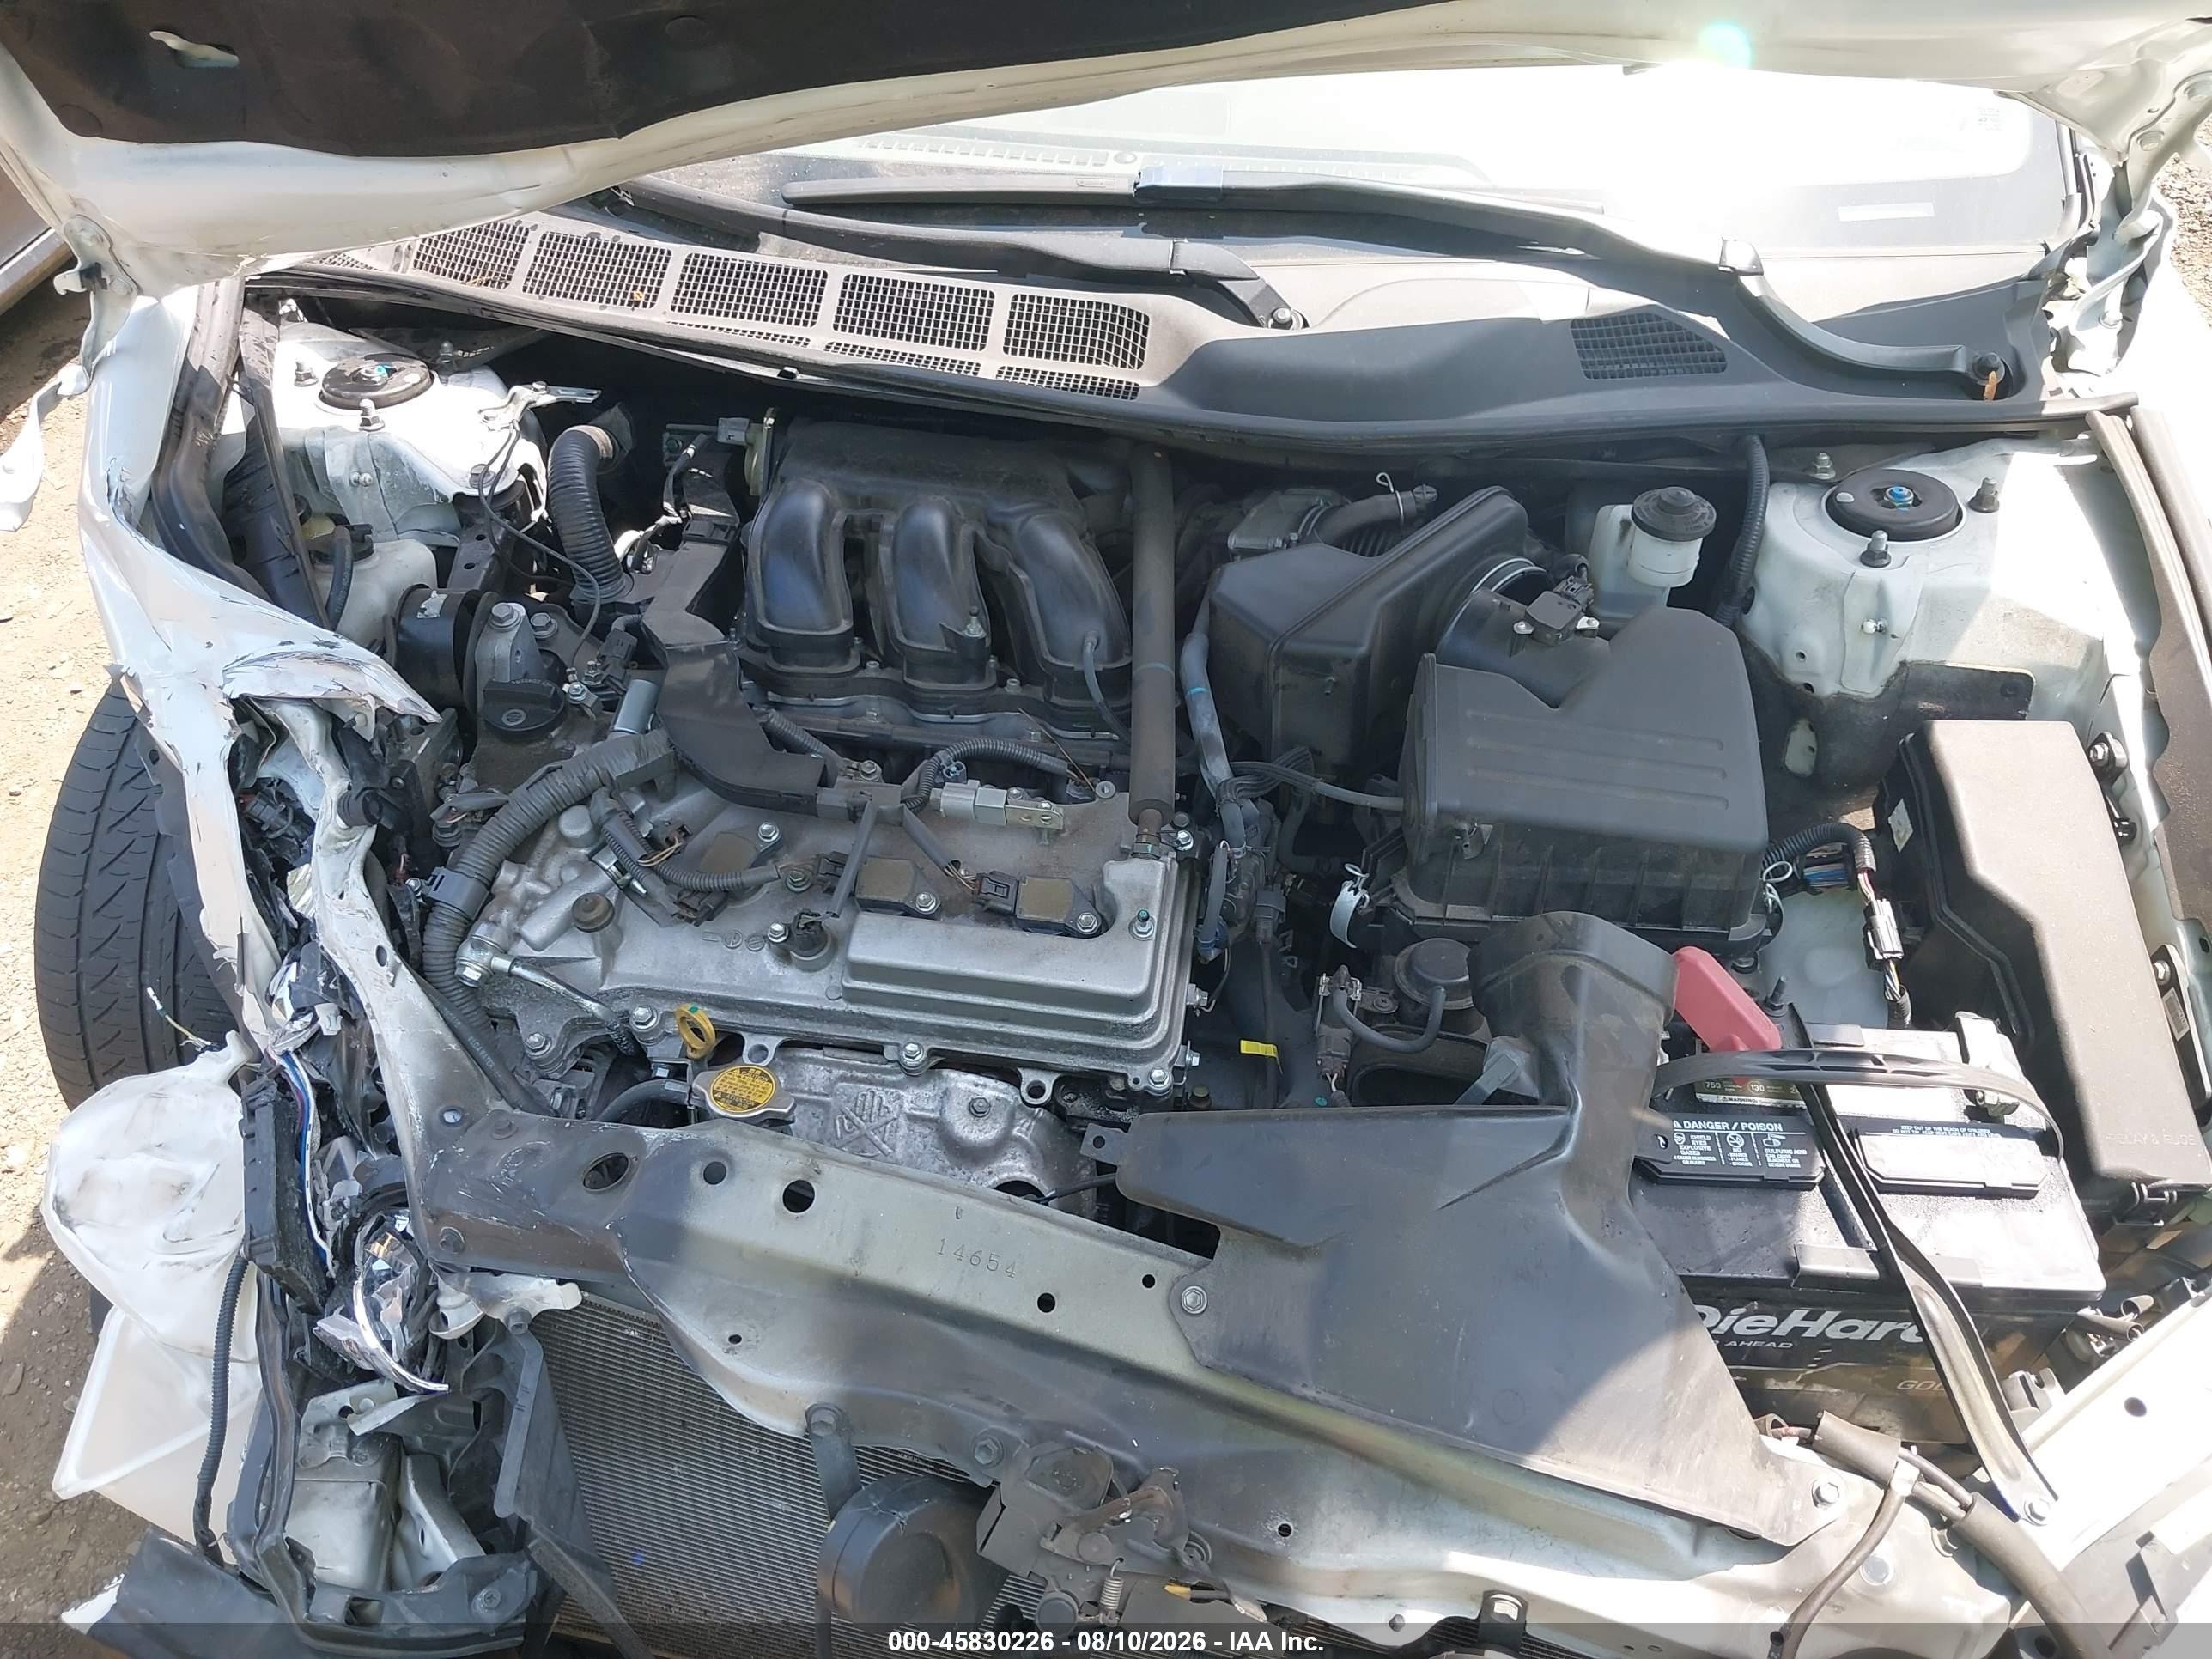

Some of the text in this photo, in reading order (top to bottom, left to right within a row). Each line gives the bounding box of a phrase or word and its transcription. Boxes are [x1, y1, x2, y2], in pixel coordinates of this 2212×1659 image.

[1750, 1084, 1765, 1092] 130
[1683, 1121, 1783, 1132] DANGER / POISON
[937, 1238, 1017, 1279] 14654
[1724, 1340, 1793, 1349] AHEAD
